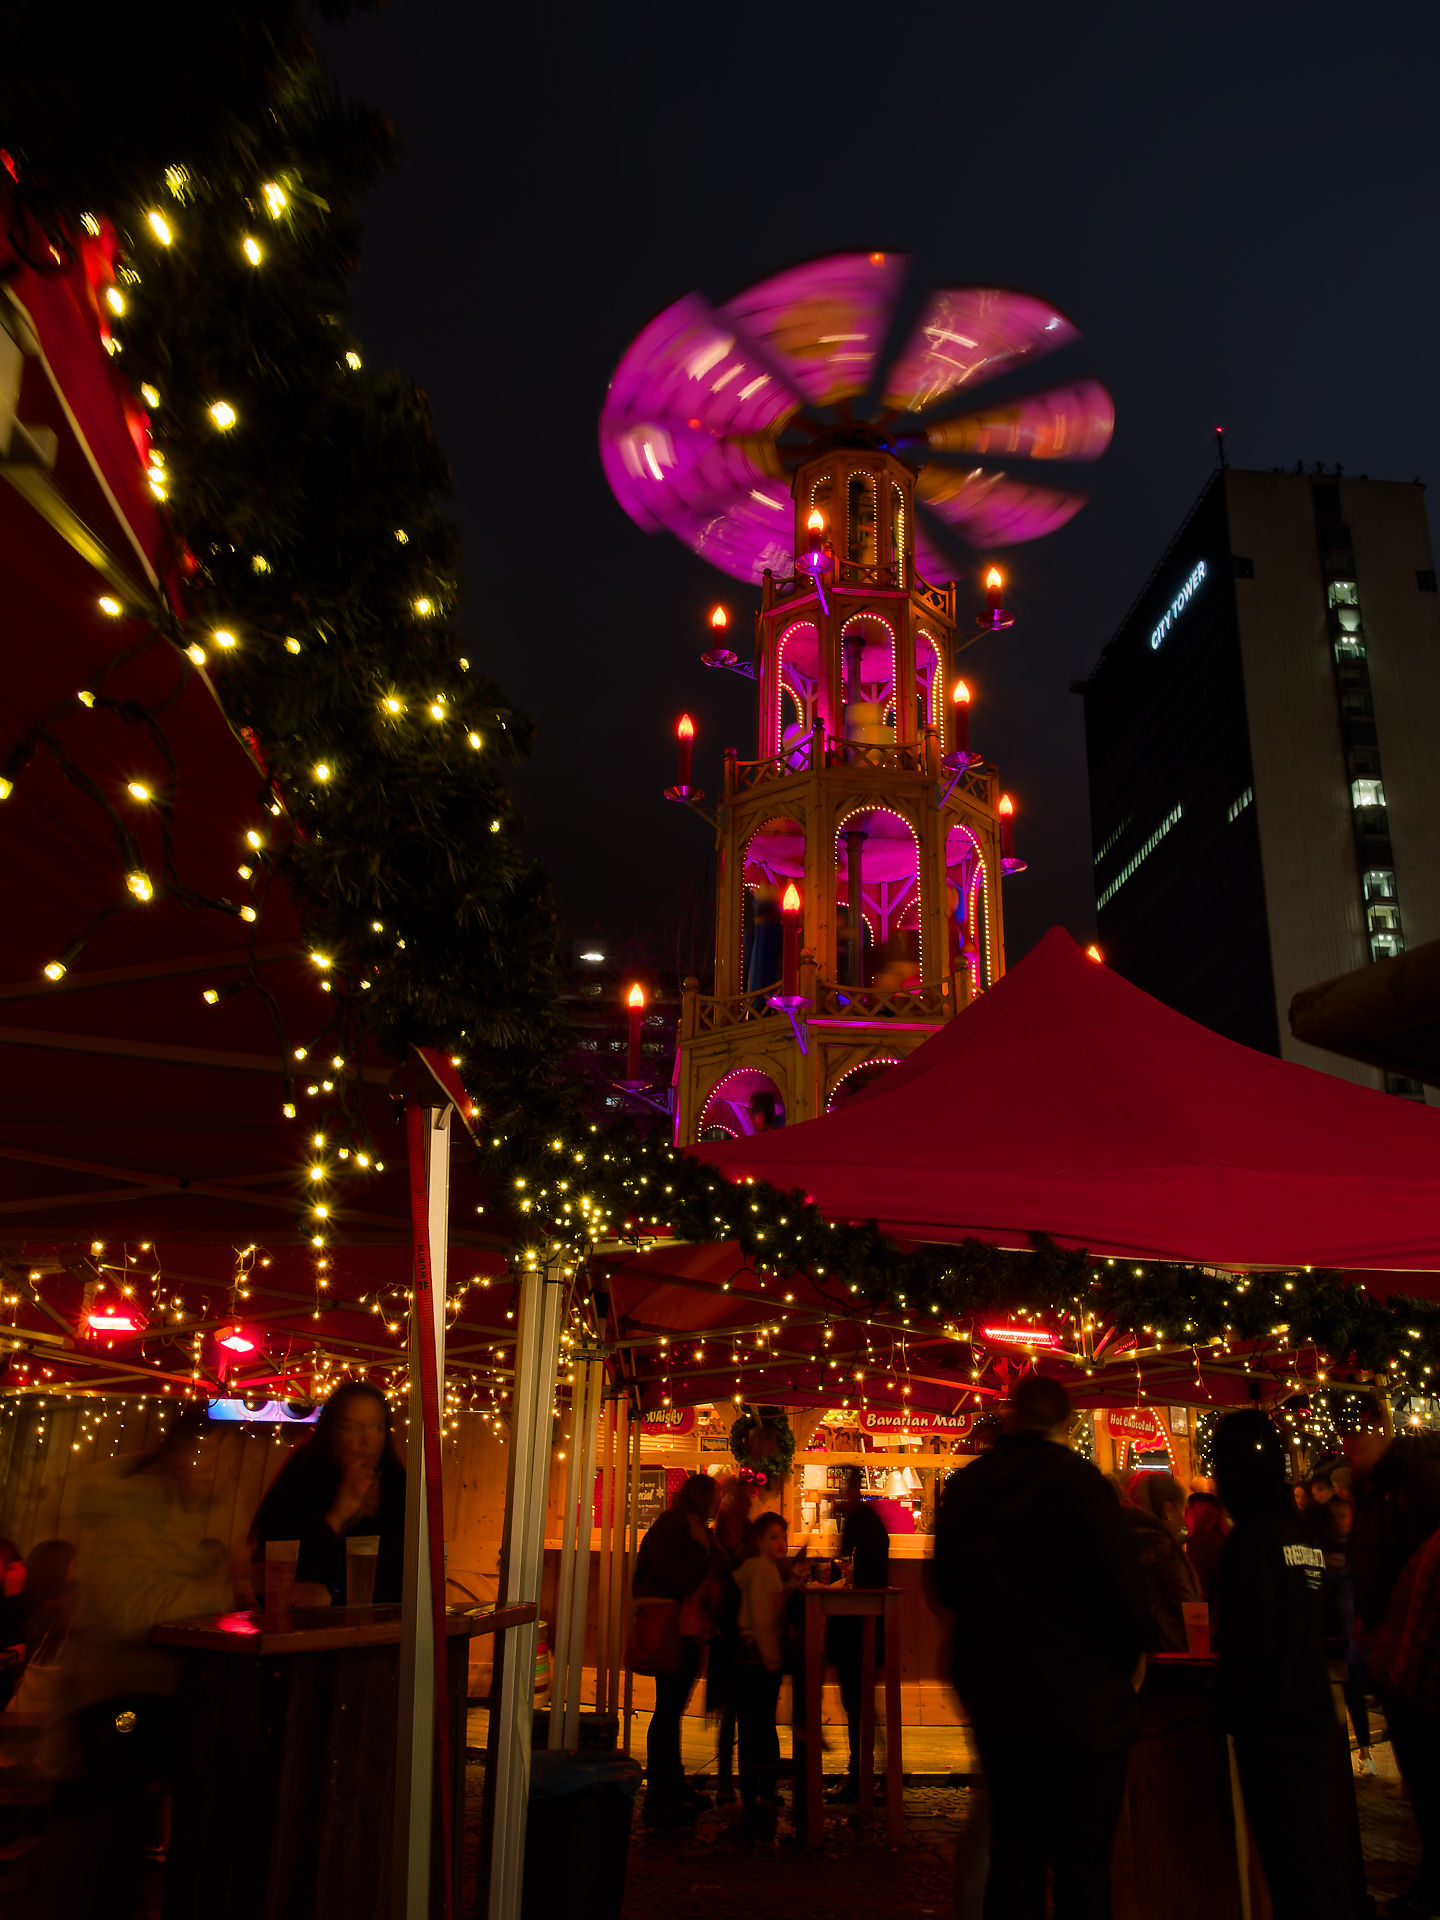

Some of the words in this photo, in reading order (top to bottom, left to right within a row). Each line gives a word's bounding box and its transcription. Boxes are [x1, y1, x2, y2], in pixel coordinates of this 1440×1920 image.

[1151, 609, 1172, 650] CITY
[1171, 560, 1207, 619] TOWER
[866, 1413, 929, 1427] Bavarian
[932, 1414, 966, 1427] Maß
[1110, 1413, 1123, 1426] Hot
[1123, 1416, 1155, 1432] Chocolate
